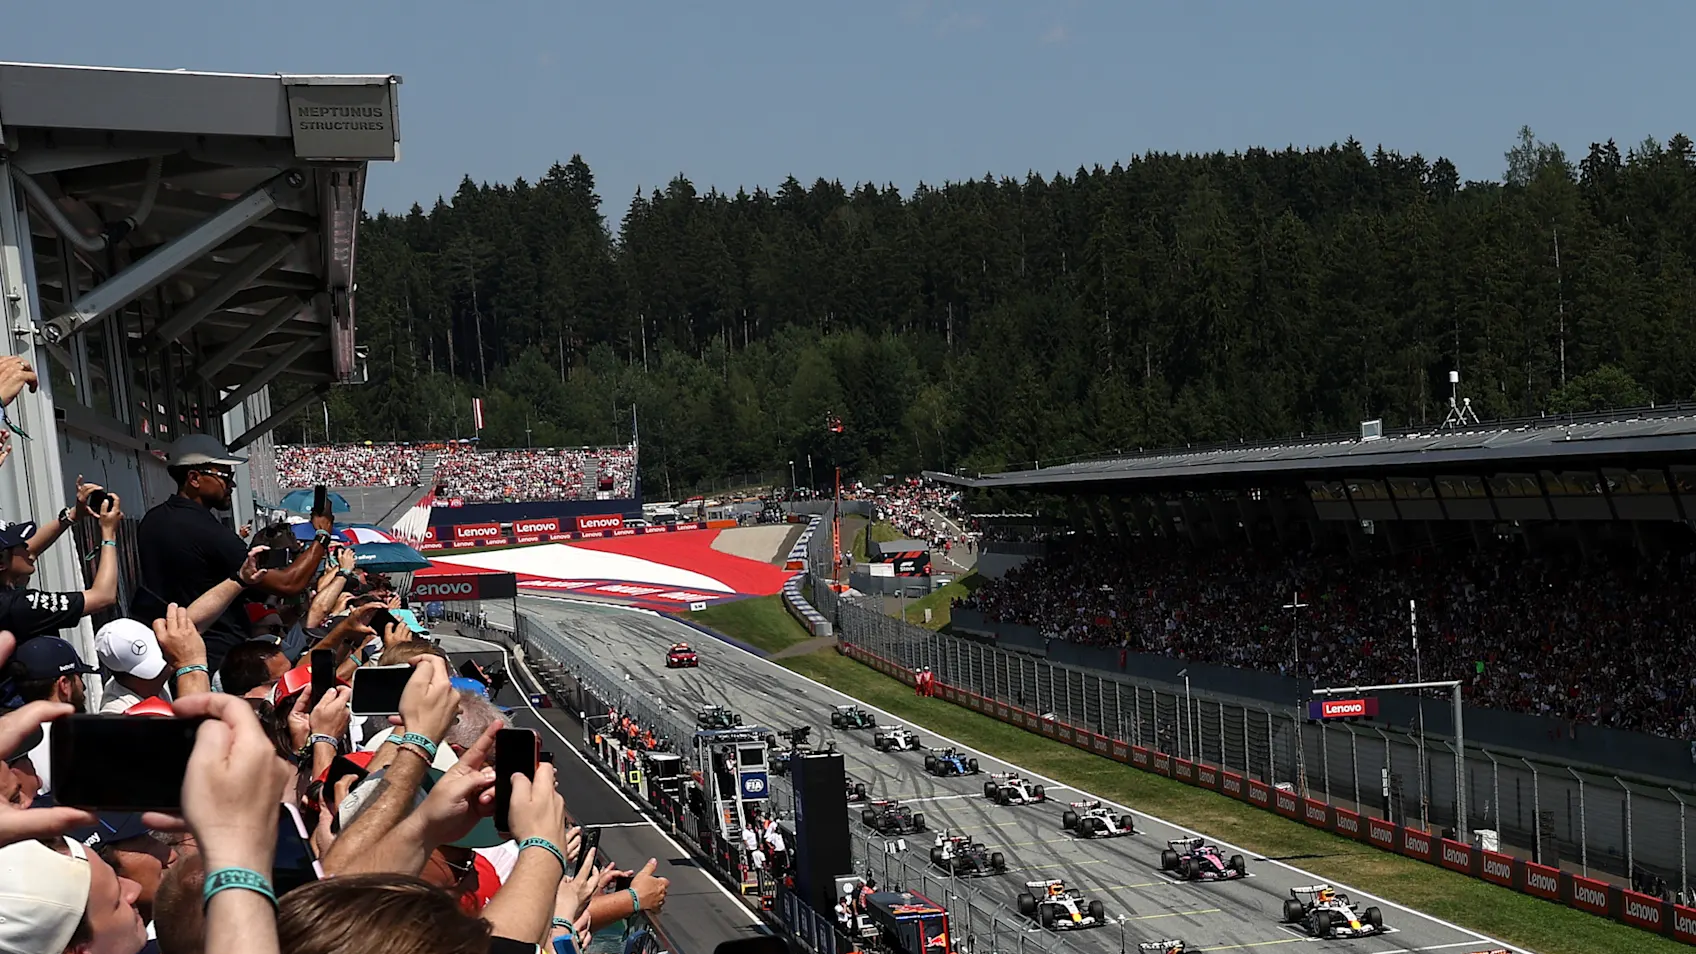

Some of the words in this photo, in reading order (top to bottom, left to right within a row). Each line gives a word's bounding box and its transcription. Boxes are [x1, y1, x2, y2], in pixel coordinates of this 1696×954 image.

[298, 107, 383, 117] NEPTUNUS
[300, 122, 384, 130] STRUCTURES
[457, 527, 498, 538] Lenovo
[516, 522, 556, 534] Lenovo
[580, 517, 620, 529] Lenovo
[416, 580, 473, 596] enovo
[1325, 700, 1363, 714] Lenovo
[748, 781, 762, 790] FIA
[1199, 768, 1215, 784] Lenovo
[1223, 775, 1240, 793] Lenovo
[1250, 783, 1267, 802] Lenovo
[1276, 793, 1295, 812] Lenovo
[1305, 802, 1326, 822] Lenovo
[1336, 812, 1358, 832] Lenovo
[1370, 822, 1392, 843] Lenovo
[1405, 833, 1428, 854] Lenovo
[1443, 843, 1468, 867] Lenovo
[1483, 856, 1511, 879] Lenovo
[1527, 867, 1557, 893] Lenovo
[1574, 881, 1606, 908] Lenovo
[1625, 896, 1659, 923] Lenovo
